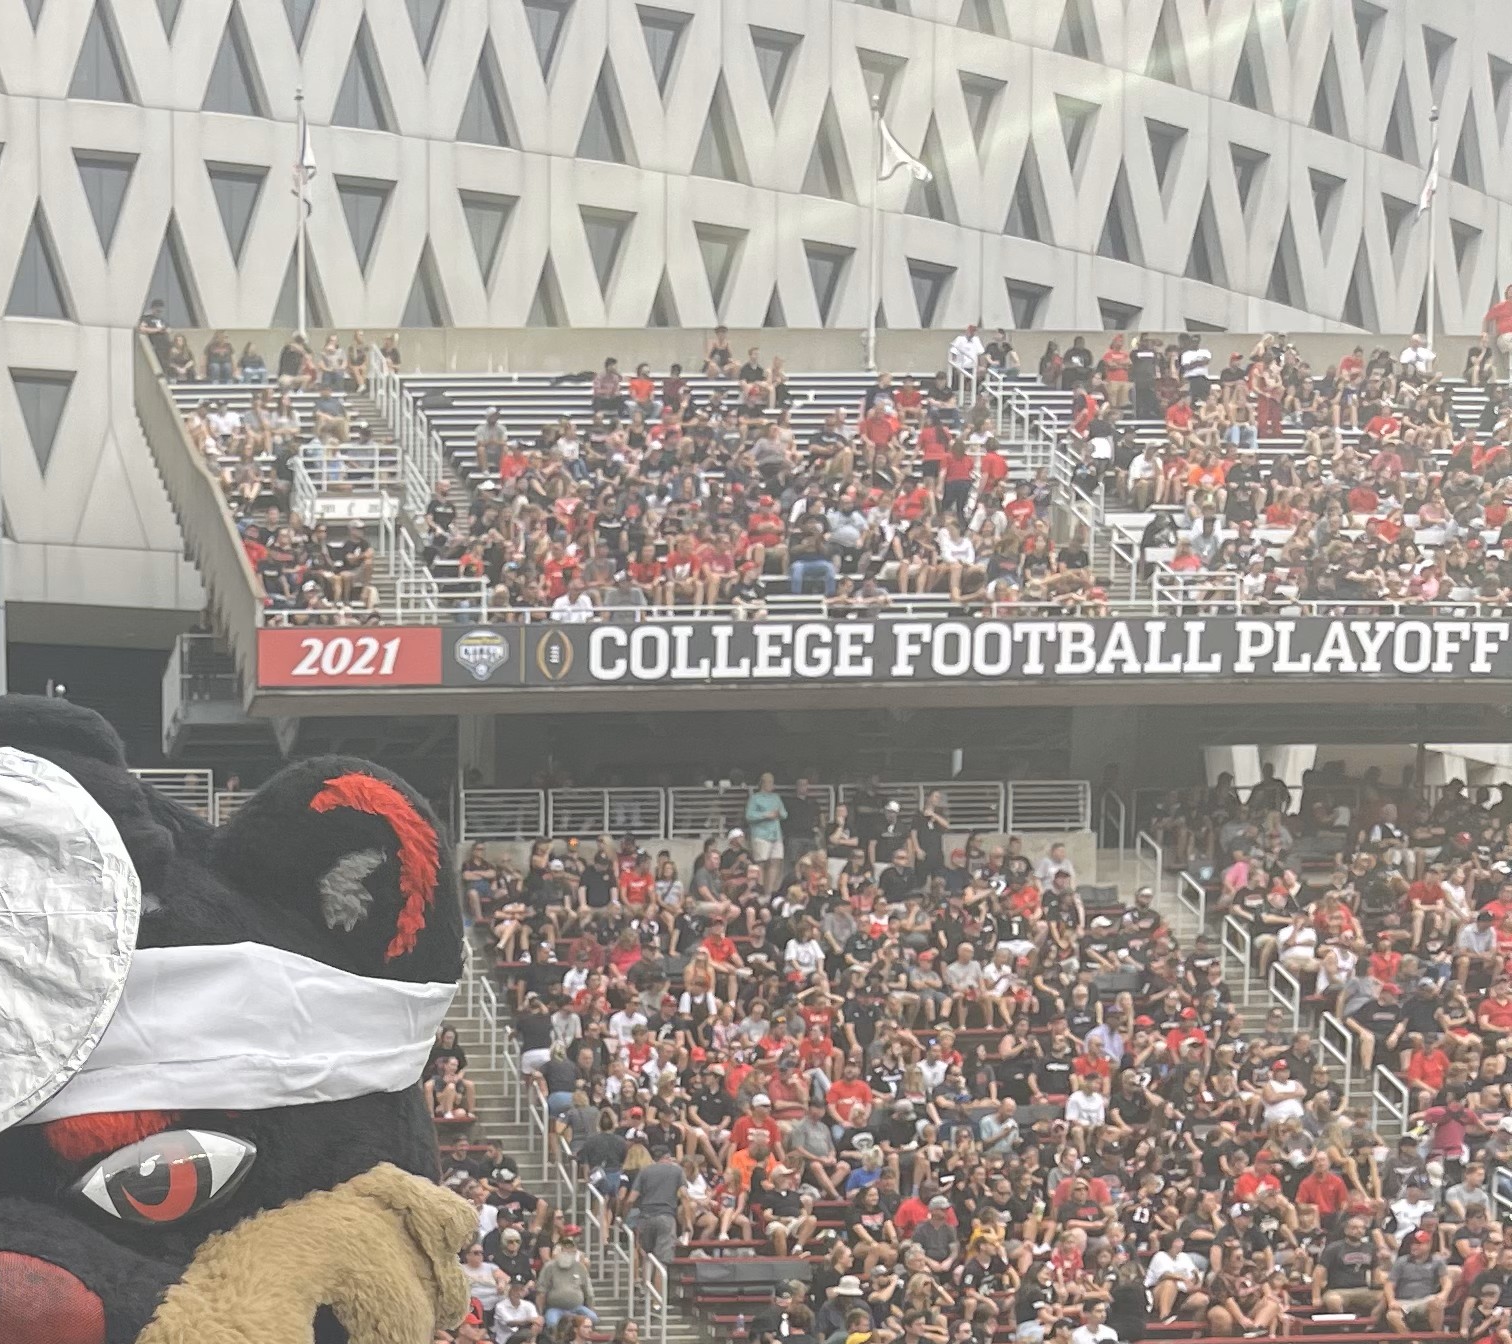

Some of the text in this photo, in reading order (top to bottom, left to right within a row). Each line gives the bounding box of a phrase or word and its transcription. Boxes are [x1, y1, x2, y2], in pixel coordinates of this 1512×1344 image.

[291, 637, 400, 676] 2021
[589, 624, 874, 681] COLLEGE
[890, 621, 1221, 677] FOOTBALL
[1233, 620, 1510, 674] PLAYOFF
